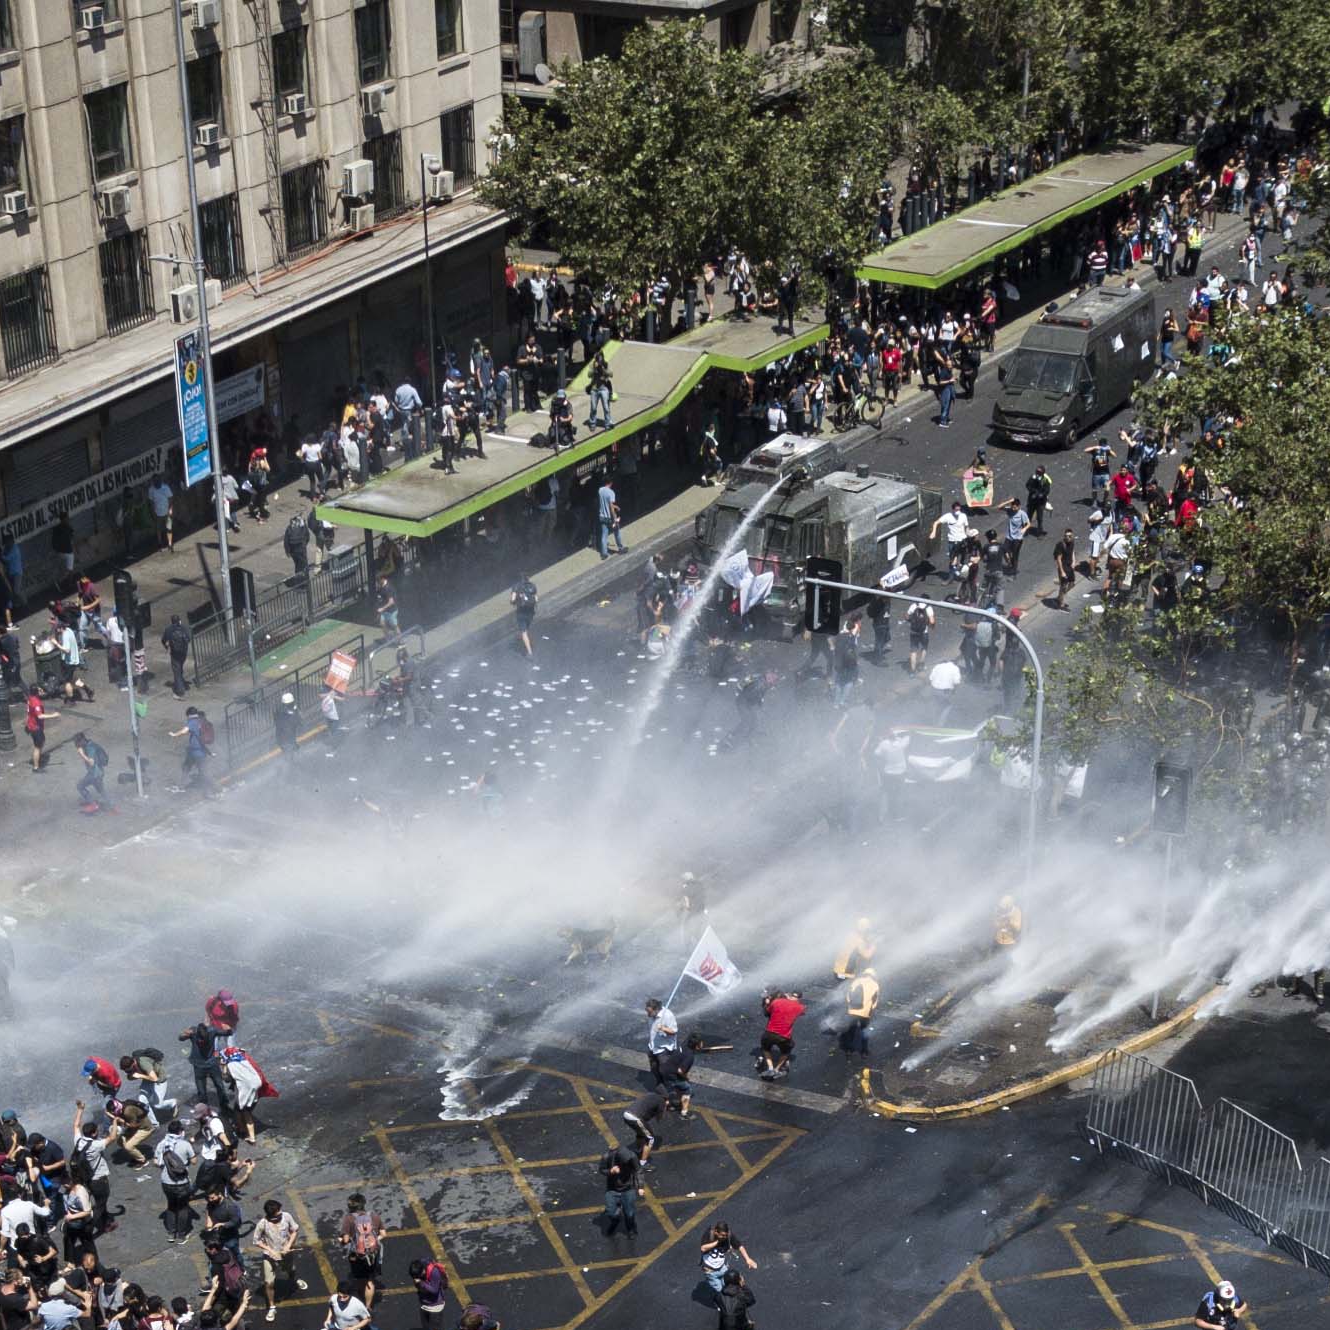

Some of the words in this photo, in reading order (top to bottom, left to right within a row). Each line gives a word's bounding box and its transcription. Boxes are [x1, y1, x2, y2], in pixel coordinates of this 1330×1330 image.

[36, 510, 48, 528] AL
[48, 485, 85, 522] SERVICIO
[86, 482, 98, 500] DE
[97, 473, 114, 495] LAS
